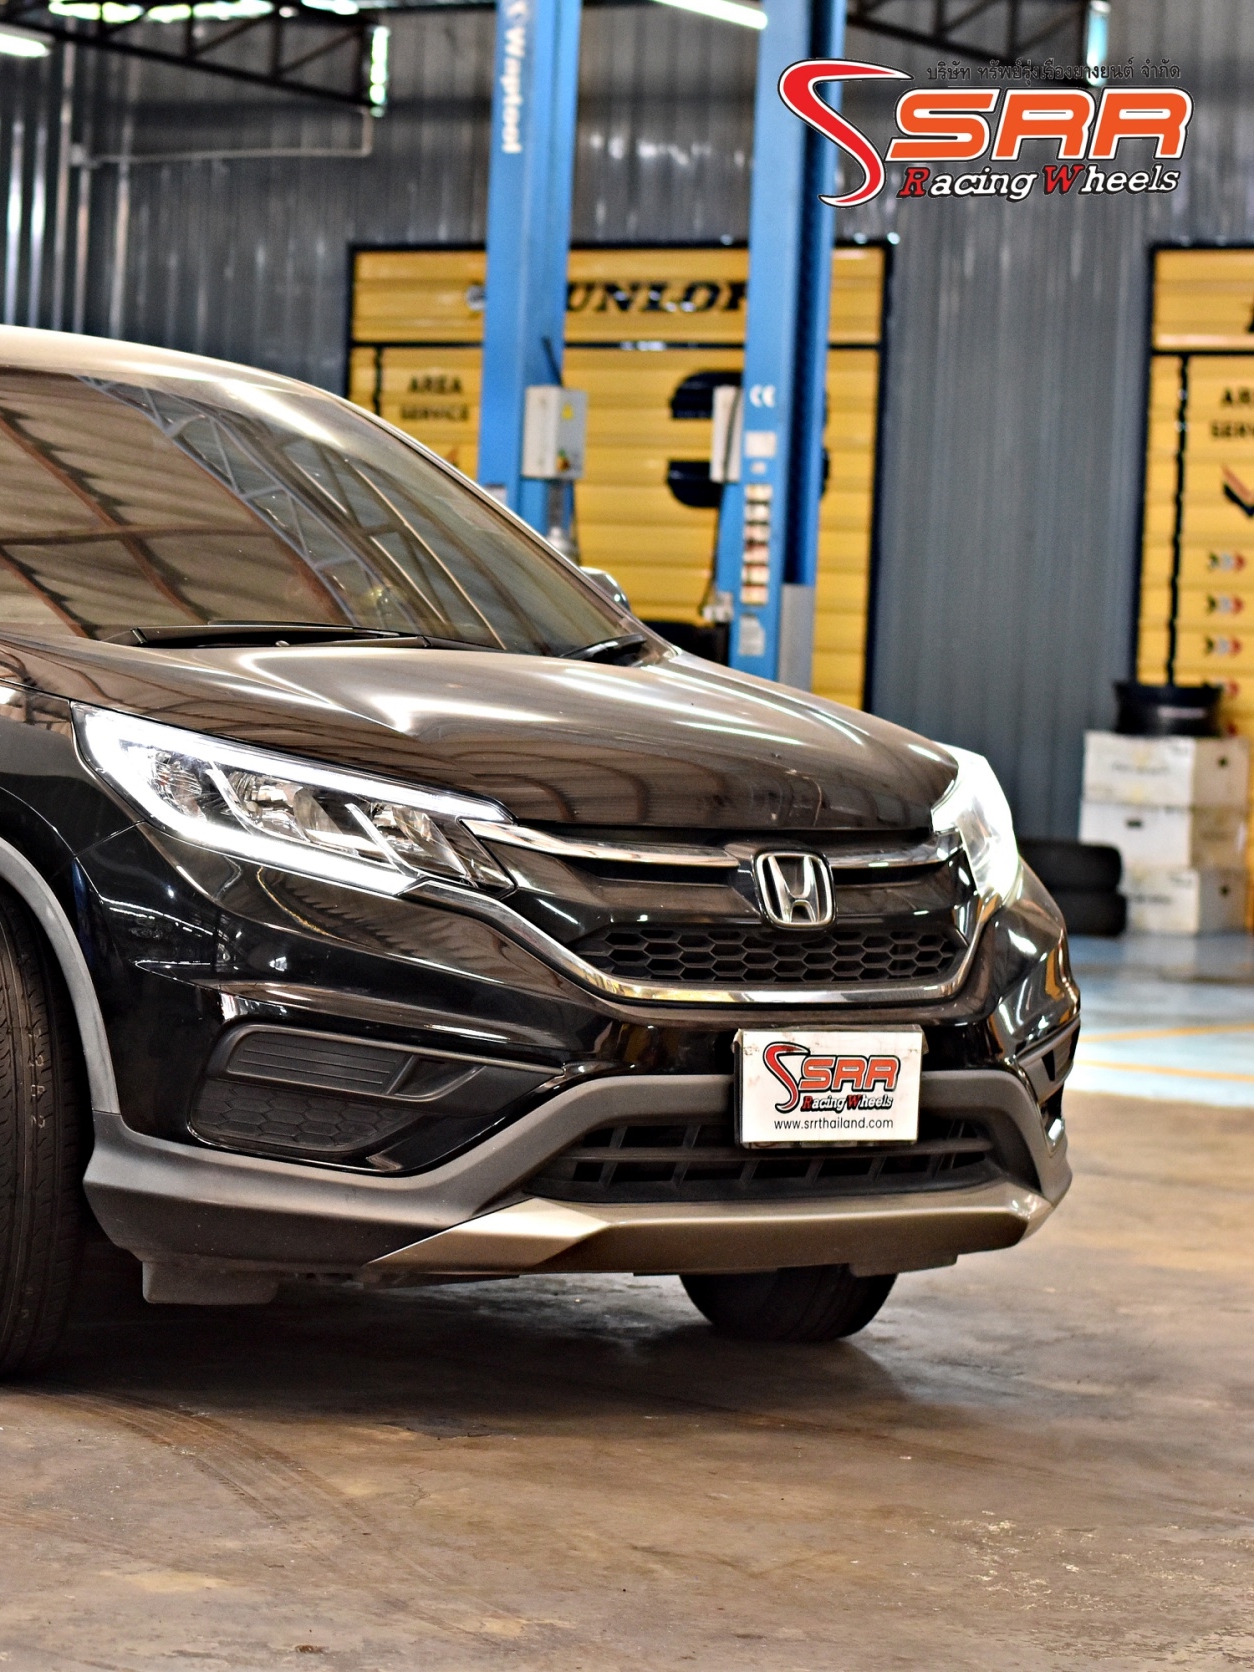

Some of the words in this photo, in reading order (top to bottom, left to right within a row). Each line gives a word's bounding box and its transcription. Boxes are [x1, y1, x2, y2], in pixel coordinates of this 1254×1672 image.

[801, 1096, 847, 1113] Racing
[847, 1095, 893, 1111] Wheels
[774, 1118, 894, 1129] www.srrthailand.com
